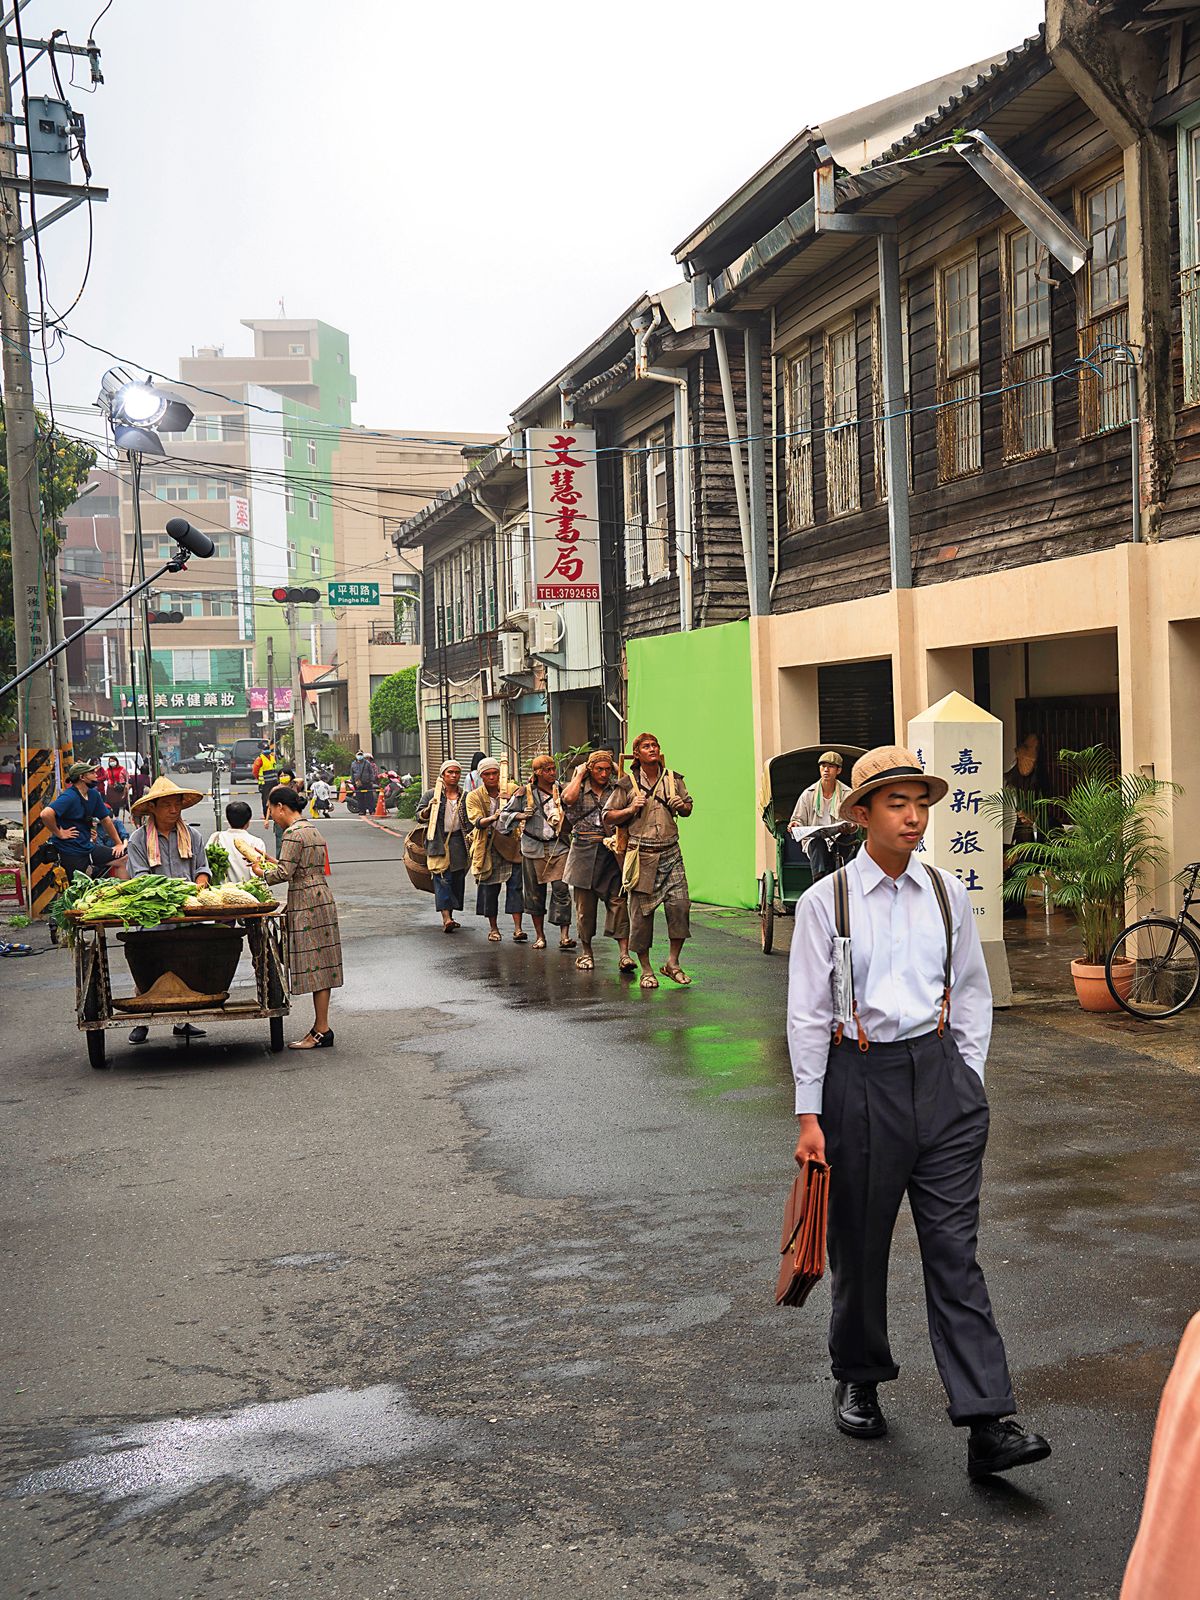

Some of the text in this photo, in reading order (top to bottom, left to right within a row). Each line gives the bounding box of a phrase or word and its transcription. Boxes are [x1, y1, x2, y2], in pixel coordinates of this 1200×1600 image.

[544, 435, 587, 582] 文慧書局
[337, 585, 370, 596] 平和路
[539, 588, 598, 599] TEL:3792456
[137, 693, 236, 708] 榮美保健藥妝
[948, 748, 985, 891] 嘉新旅社
